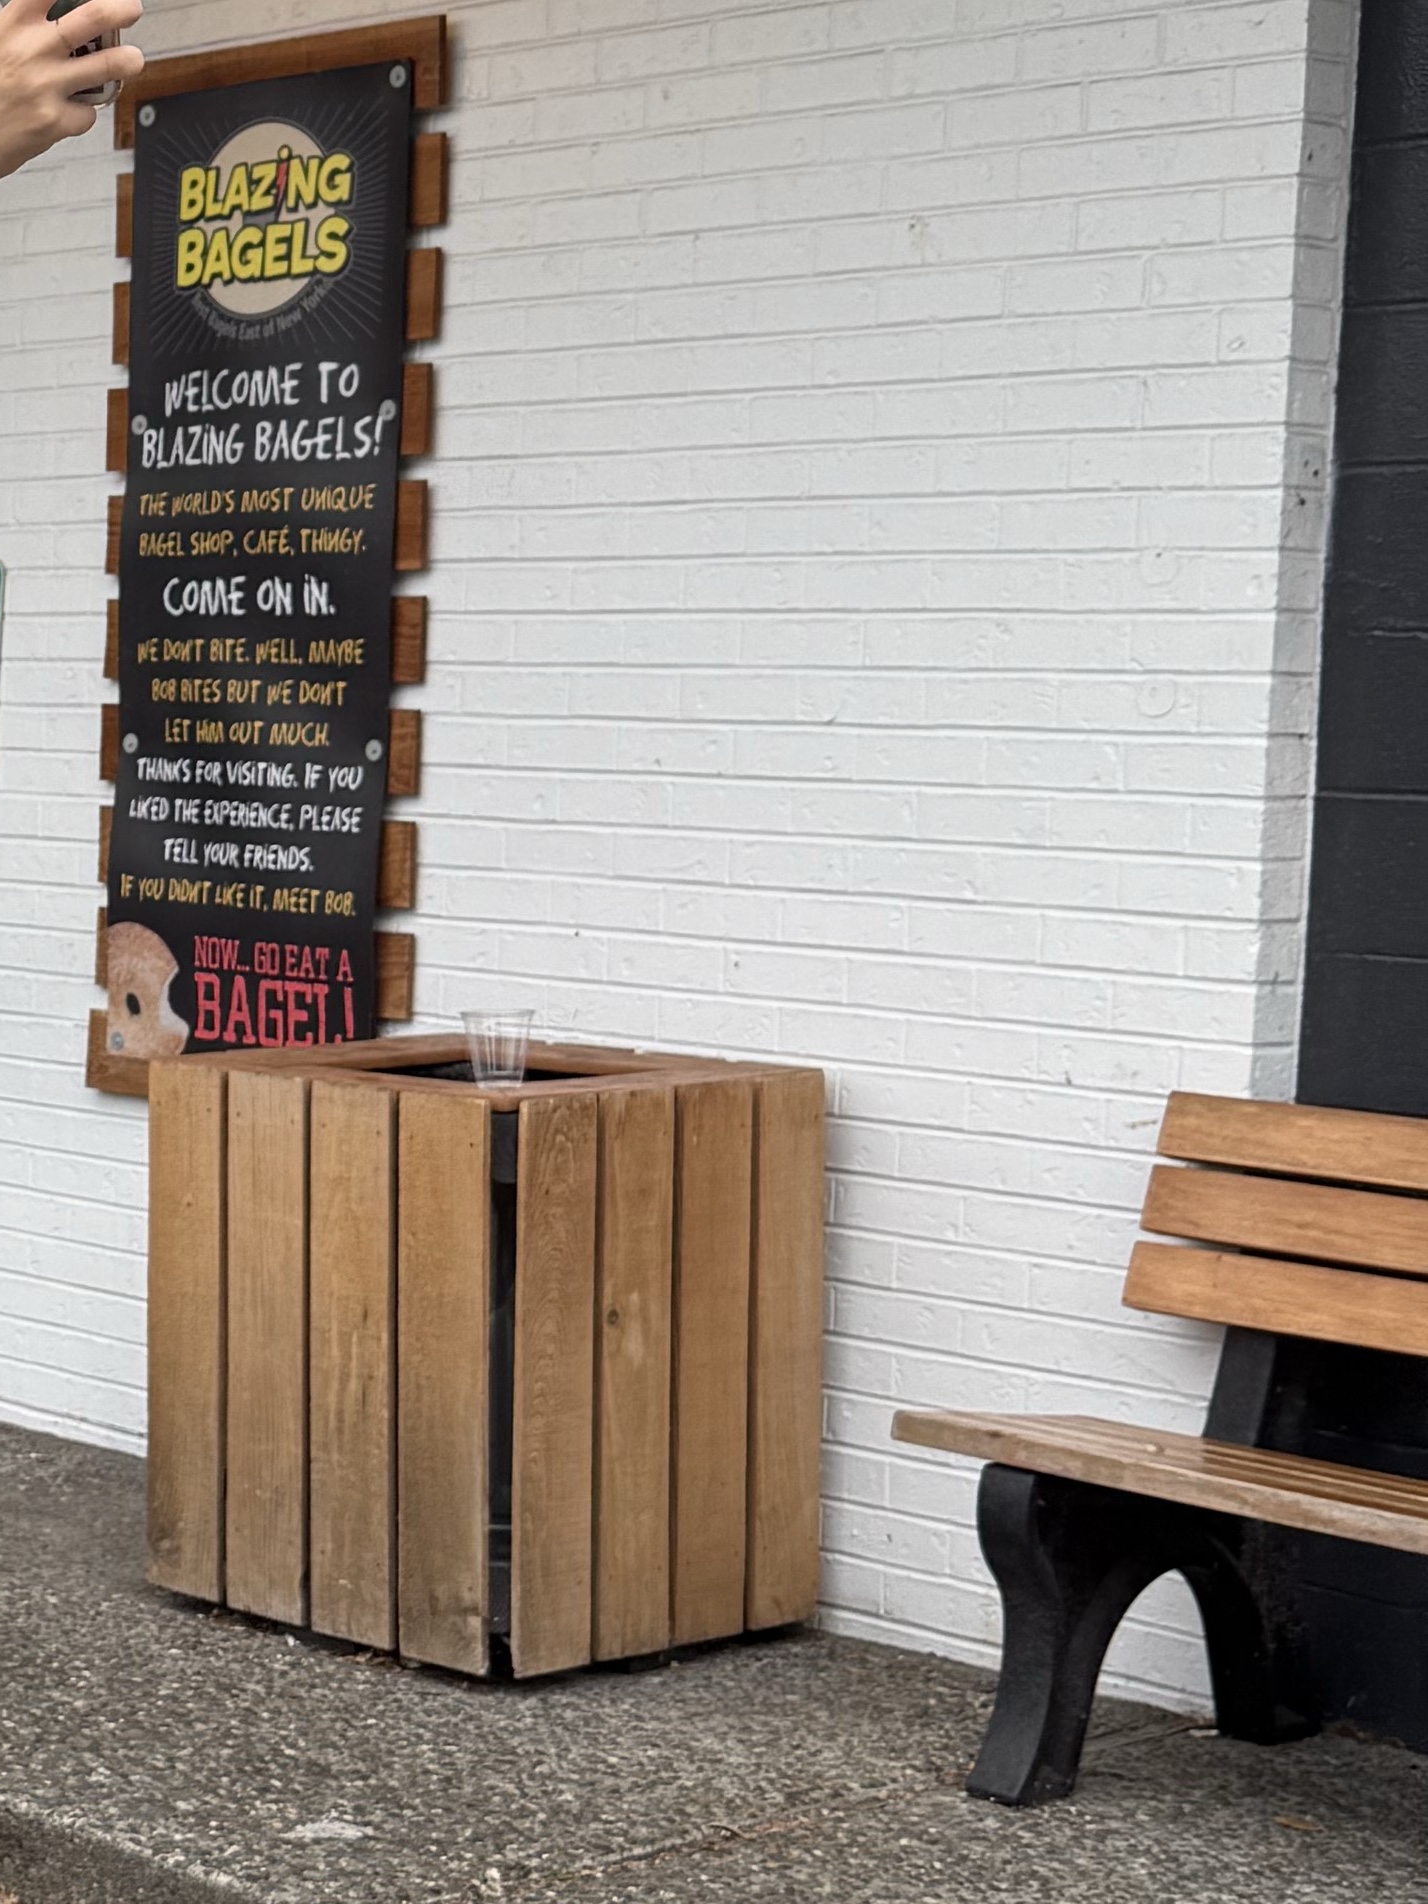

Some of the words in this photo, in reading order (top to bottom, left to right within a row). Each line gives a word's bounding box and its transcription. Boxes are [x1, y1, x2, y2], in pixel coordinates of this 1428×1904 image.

[179, 144, 353, 223] BLAZING
[176, 215, 351, 288] BAGELS
[164, 362, 303, 417] WELCOME
[318, 361, 360, 404] TO
[141, 422, 245, 469] BLAZING
[254, 414, 384, 462] BAGELS!
[139, 491, 168, 517] THE
[171, 489, 236, 518] WORLD'S
[240, 486, 295, 513] MOST
[300, 483, 378, 513] UNIQUE
[138, 532, 185, 557] BAGEL
[190, 529, 239, 557] SHOP,
[299, 527, 367, 555] THINGY.
[162, 575, 247, 617] COME
[256, 575, 293, 616] ON
[303, 573, 337, 616] IN.
[137, 637, 160, 664] WE
[209, 637, 250, 664] BITE.
[308, 638, 365, 667] MAYBE
[151, 677, 176, 702] BOB
[180, 678, 222, 703] BITES
[226, 679, 262, 704] BUT
[266, 680, 293, 706] WE
[164, 717, 192, 743] LET
[196, 718, 224, 744] HIM
[229, 720, 265, 745] OUT
[269, 721, 331, 746] MUCH.
[136, 756, 192, 783] THANKS
[195, 759, 223, 787] FOR
[226, 760, 298, 788] VISITING.
[304, 762, 324, 789] IF
[329, 765, 365, 793] YOU
[128, 796, 170, 822] LIKED
[174, 798, 201, 825] THE
[298, 803, 365, 834] PLEASE
[163, 838, 199, 864] TELL
[203, 841, 240, 869] YOUR
[243, 843, 315, 872] FRIENDS.
[120, 873, 135, 898] IF
[138, 877, 165, 903] YOU
[214, 881, 246, 909] LIKE
[272, 887, 322, 914] MEET
[324, 889, 356, 916] BOB.
[194, 935, 250, 972] NOW...
[254, 941, 280, 976] GO
[284, 944, 330, 980] EAT
[336, 948, 355, 982] A
[194, 972, 355, 1048] BAGEL!
